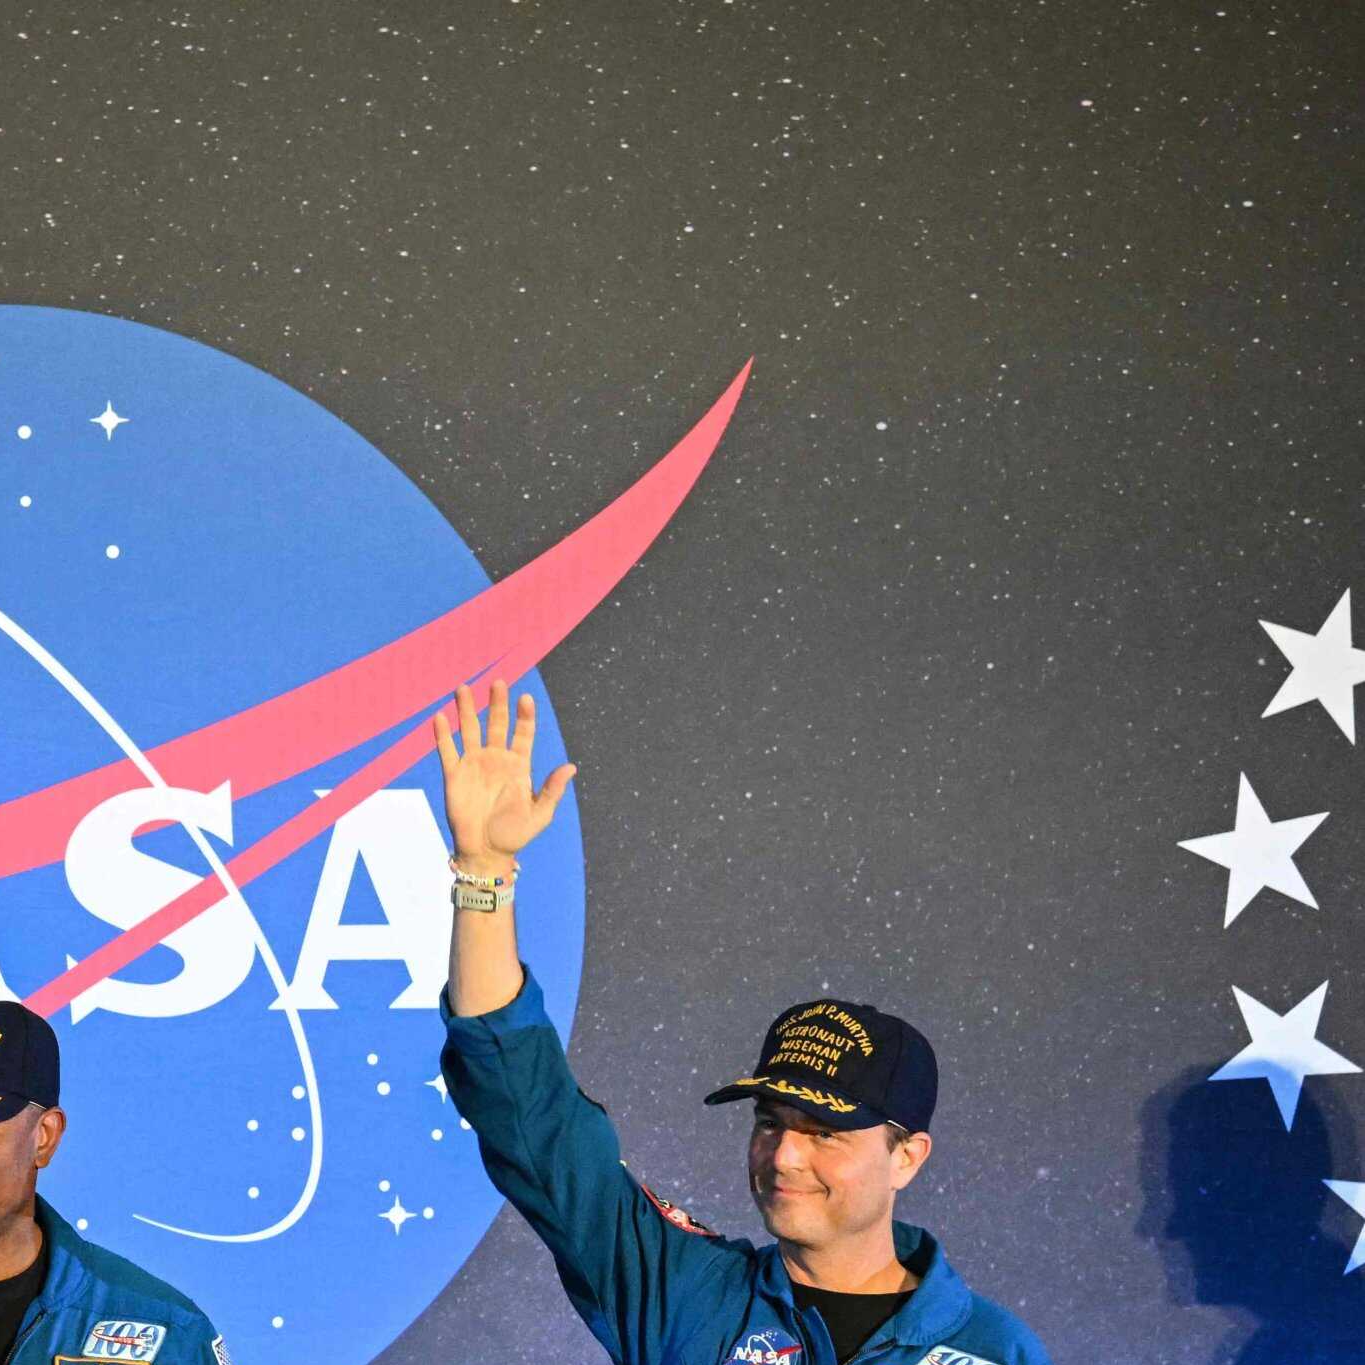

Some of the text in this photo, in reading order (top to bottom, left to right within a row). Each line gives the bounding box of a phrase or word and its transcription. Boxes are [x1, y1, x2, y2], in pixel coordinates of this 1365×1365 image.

[781, 1026, 856, 1052] ASTRONAUT
[835, 1011, 874, 1057] MURTHA
[780, 1040, 841, 1062] WISEMAN
[767, 1053, 838, 1077] ARTEMIS II
[88, 1322, 160, 1359] 100
